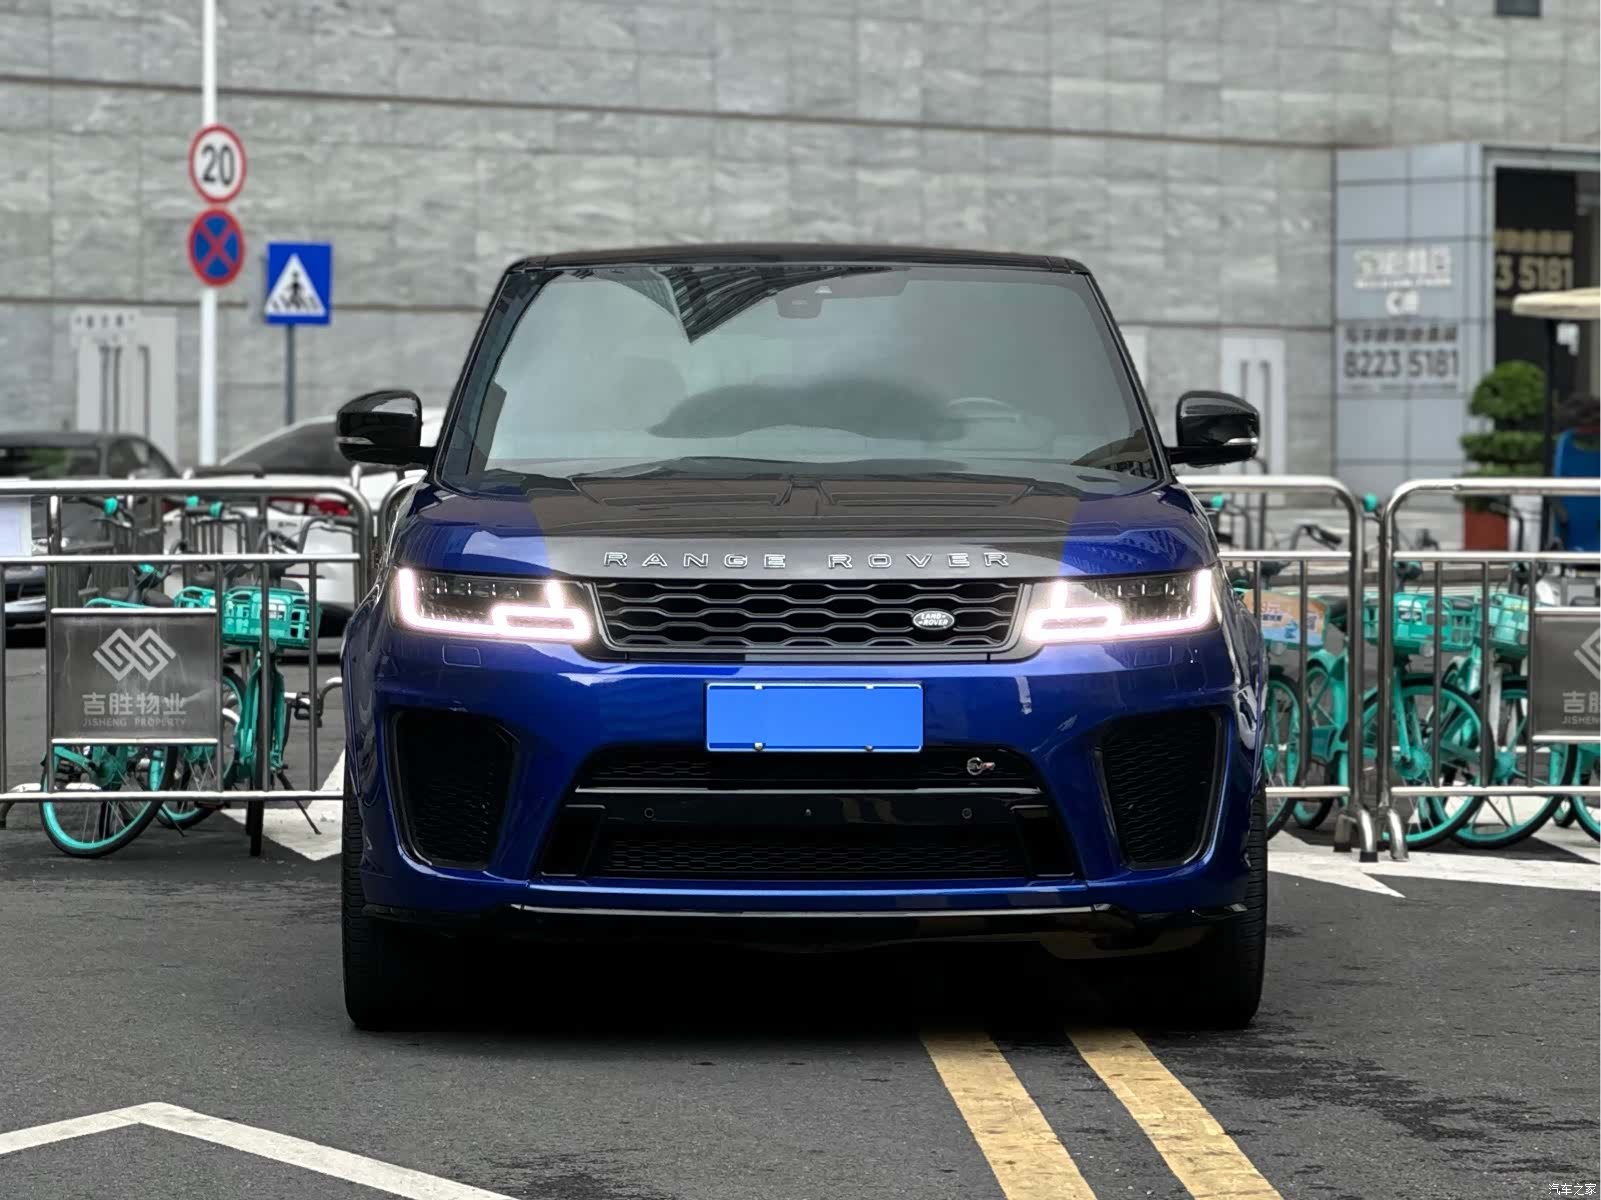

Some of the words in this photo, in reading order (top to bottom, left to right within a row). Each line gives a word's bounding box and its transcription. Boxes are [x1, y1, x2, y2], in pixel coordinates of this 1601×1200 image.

[202, 143, 236, 186] 20
[1519, 256, 1573, 290] 5181
[1345, 350, 1401, 378] 8223
[1407, 350, 1459, 378] 5181
[603, 551, 787, 569] RANGE
[828, 551, 1010, 569] ROVER
[920, 612, 942, 620] LAND
[82, 692, 186, 715] 吉胜物业
[82, 717, 127, 727] JISHENG
[135, 717, 186, 727] PROPERTY
